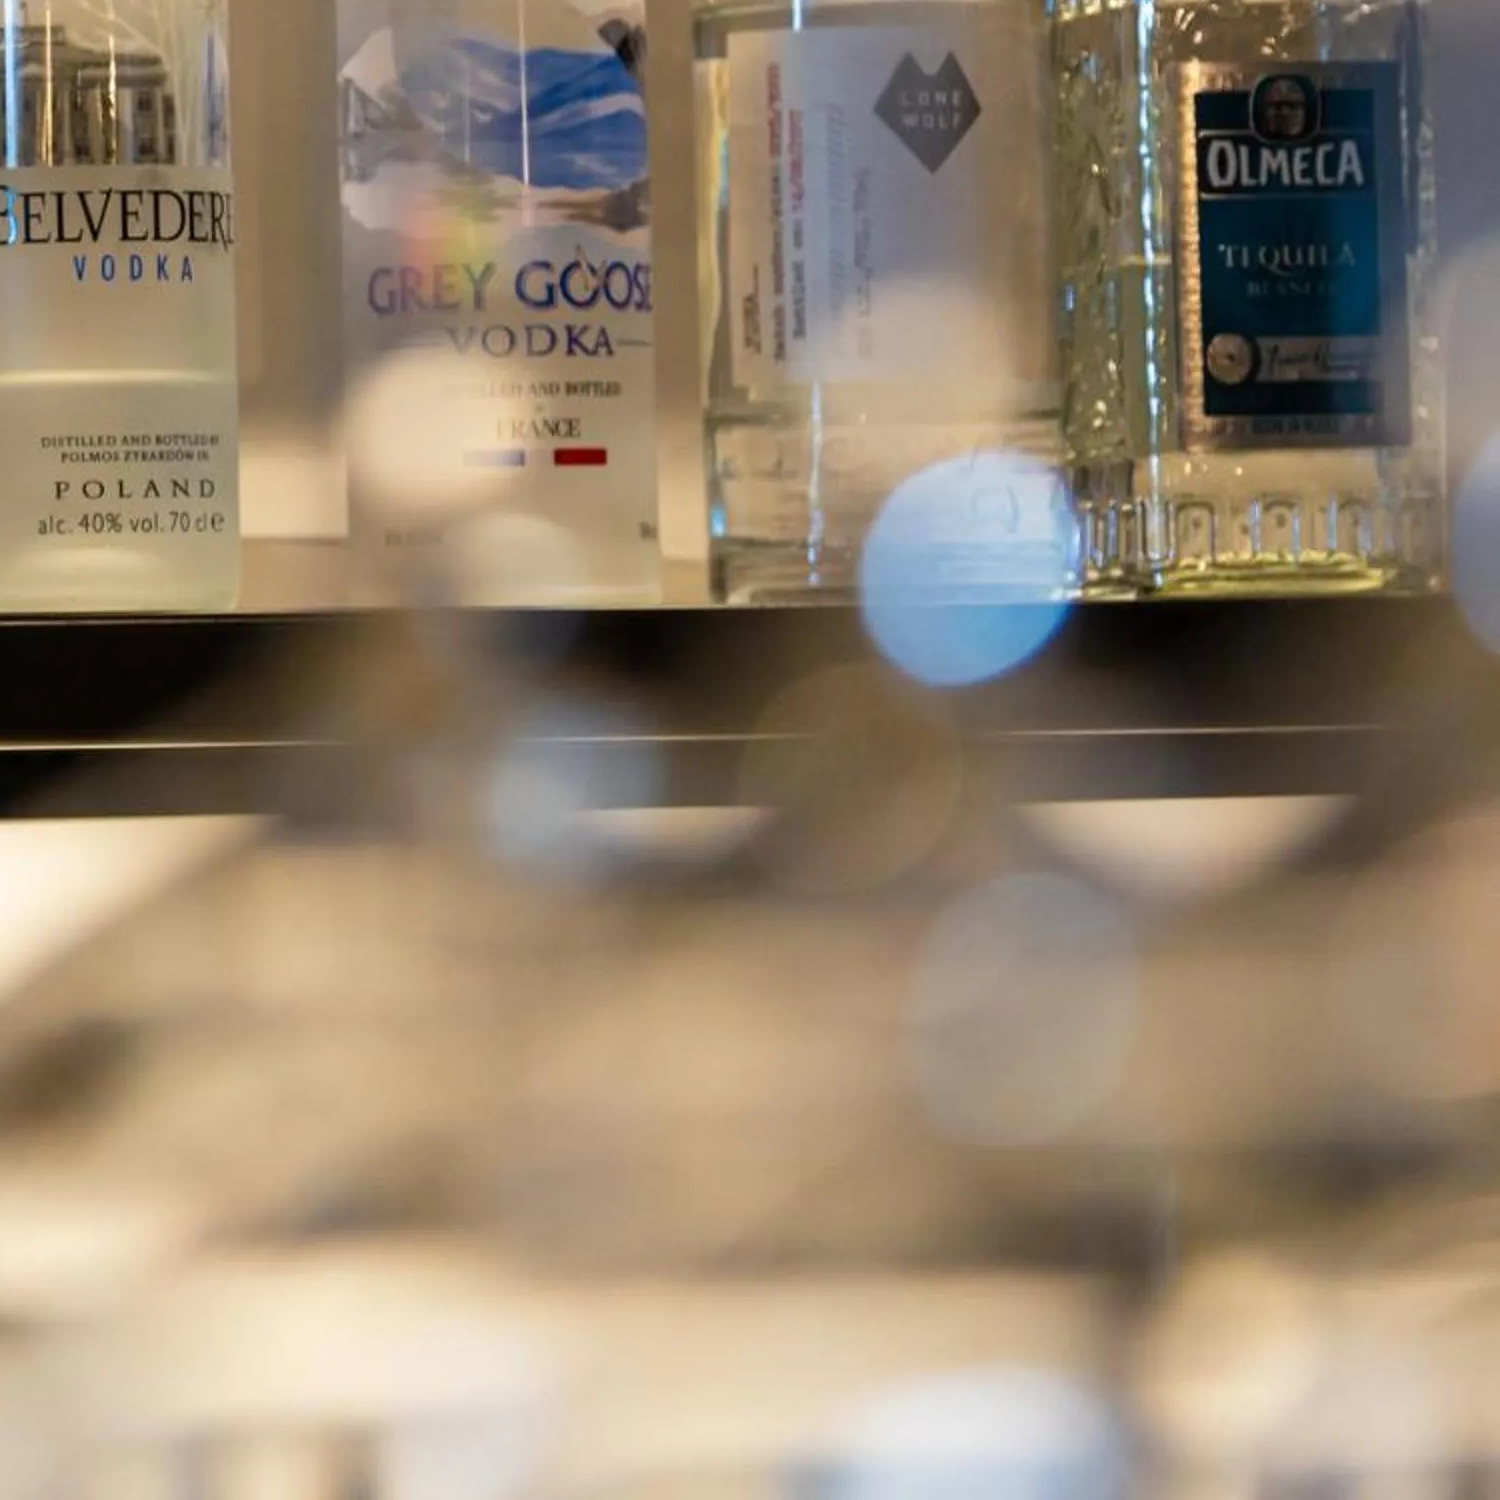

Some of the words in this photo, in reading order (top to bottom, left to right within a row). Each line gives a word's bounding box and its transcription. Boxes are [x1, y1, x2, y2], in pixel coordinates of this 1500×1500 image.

[900, 88, 960, 107] LONE
[900, 112, 961, 131] WOLF
[1206, 139, 1365, 189] OLMECA
[73, 254, 193, 282] VODKA
[368, 261, 496, 316] GREY
[446, 322, 615, 358] VODKA
[40, 435, 117, 448] DISTILLED
[121, 435, 151, 447] AND
[54, 478, 216, 500] POLAND
[78, 512, 123, 534] 40%
